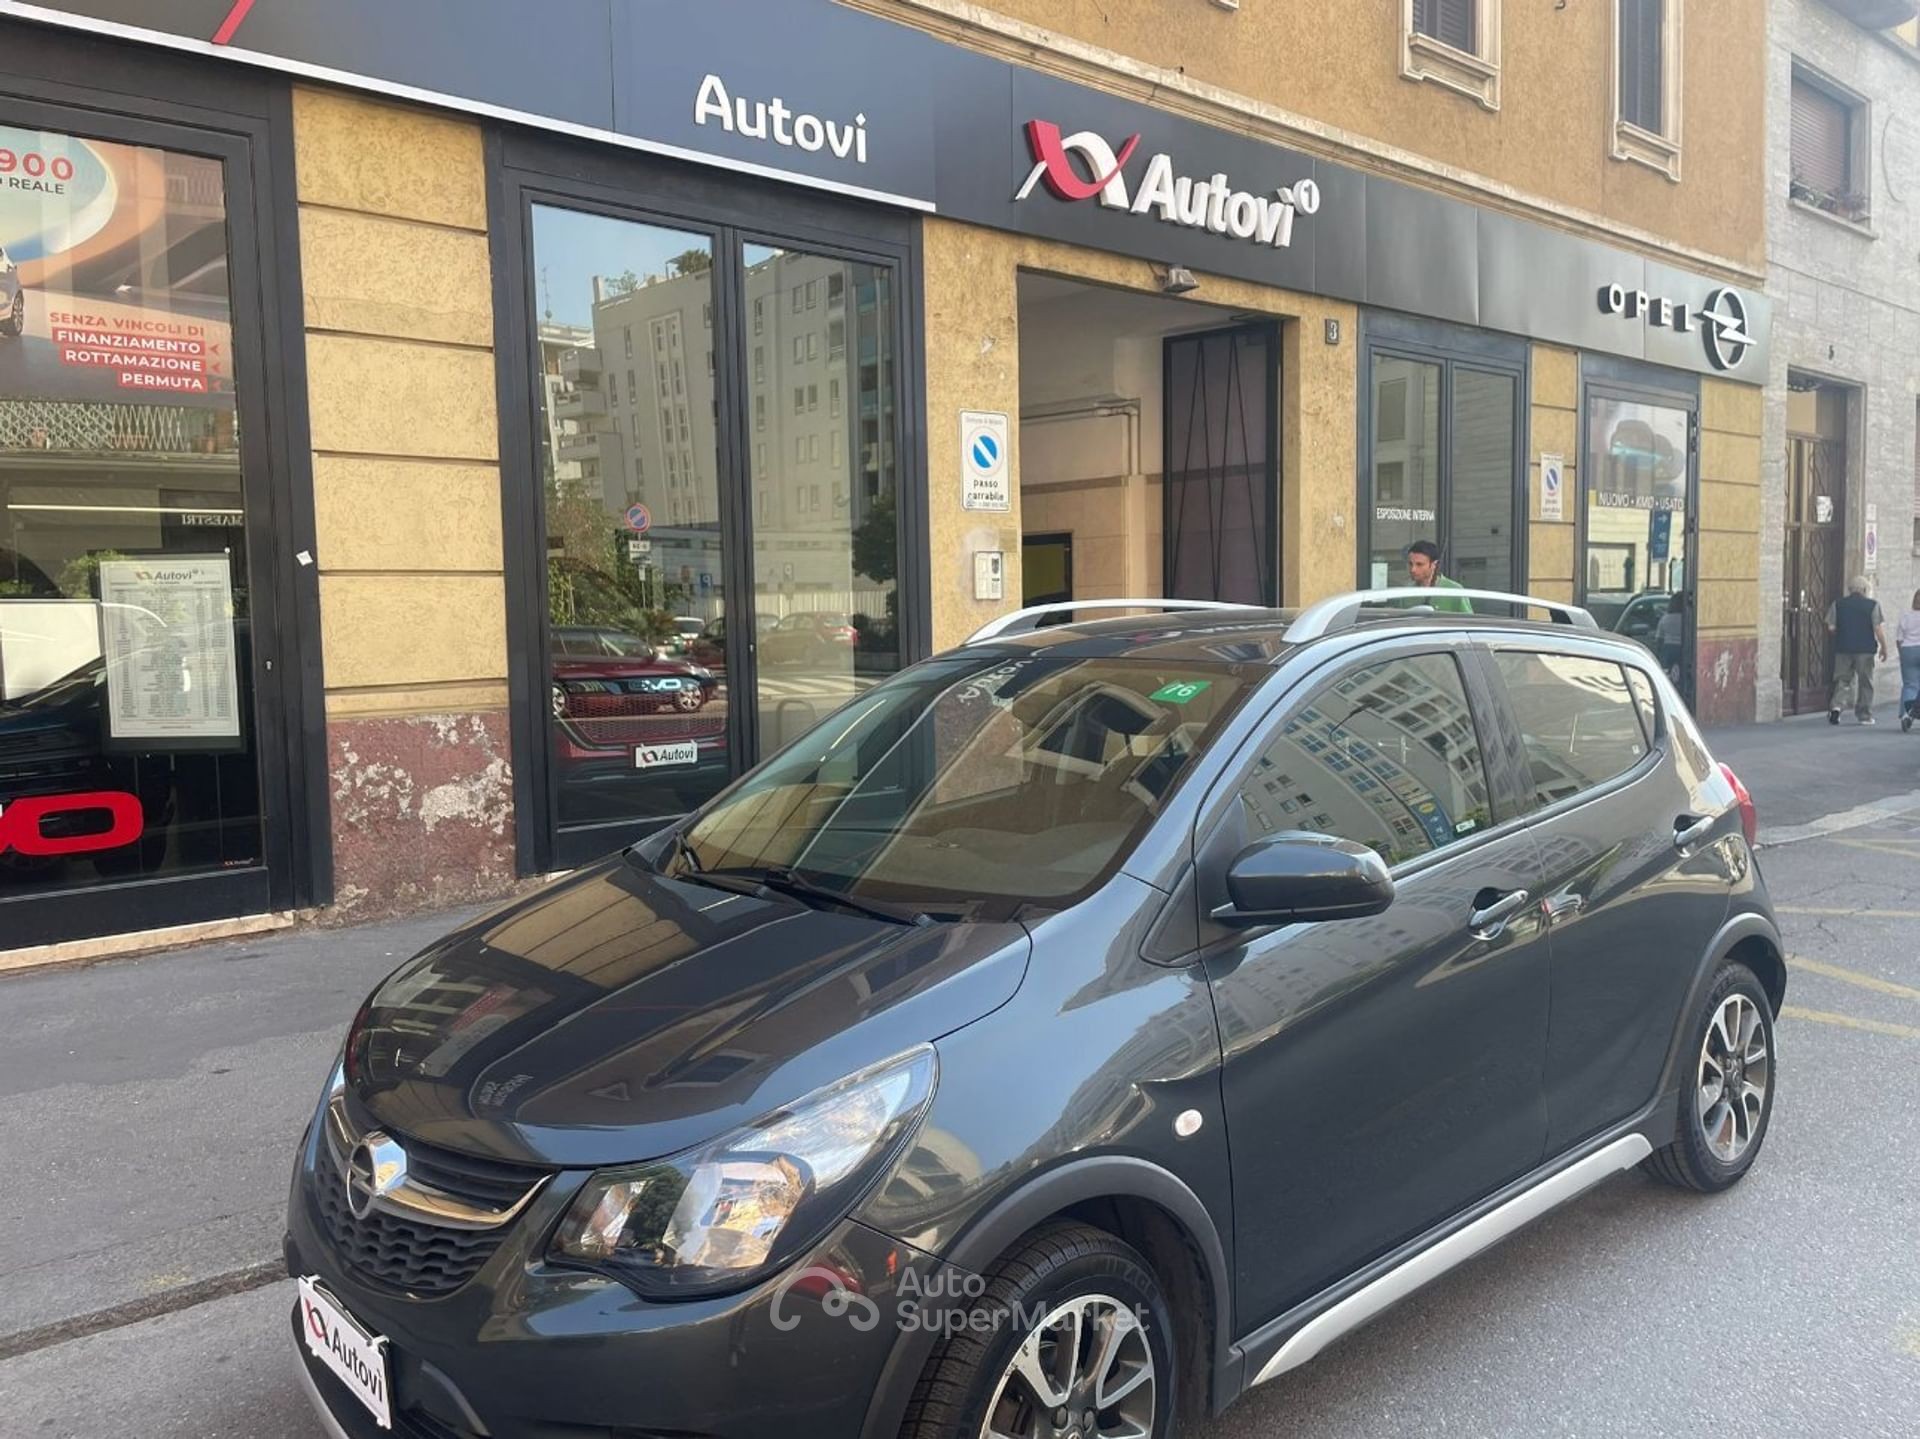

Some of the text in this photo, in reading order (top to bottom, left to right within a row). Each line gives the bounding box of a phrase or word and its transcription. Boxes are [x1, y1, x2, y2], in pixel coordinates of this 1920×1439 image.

[695, 74, 867, 163] Autovi
[9, 177, 65, 194] REALE
[1598, 283, 1695, 332] OPEL
[50, 312, 204, 337] SENZA VINCOLI DI
[1329, 322, 1338, 340] 3
[58, 330, 201, 354] FINANZIAMENTO
[65, 350, 202, 372] ROTTAMAZIONE
[122, 373, 203, 390] PERMUTA
[973, 479, 998, 490] passo
[1599, 493, 1630, 507] NUOVO
[1660, 497, 1685, 511] USATO
